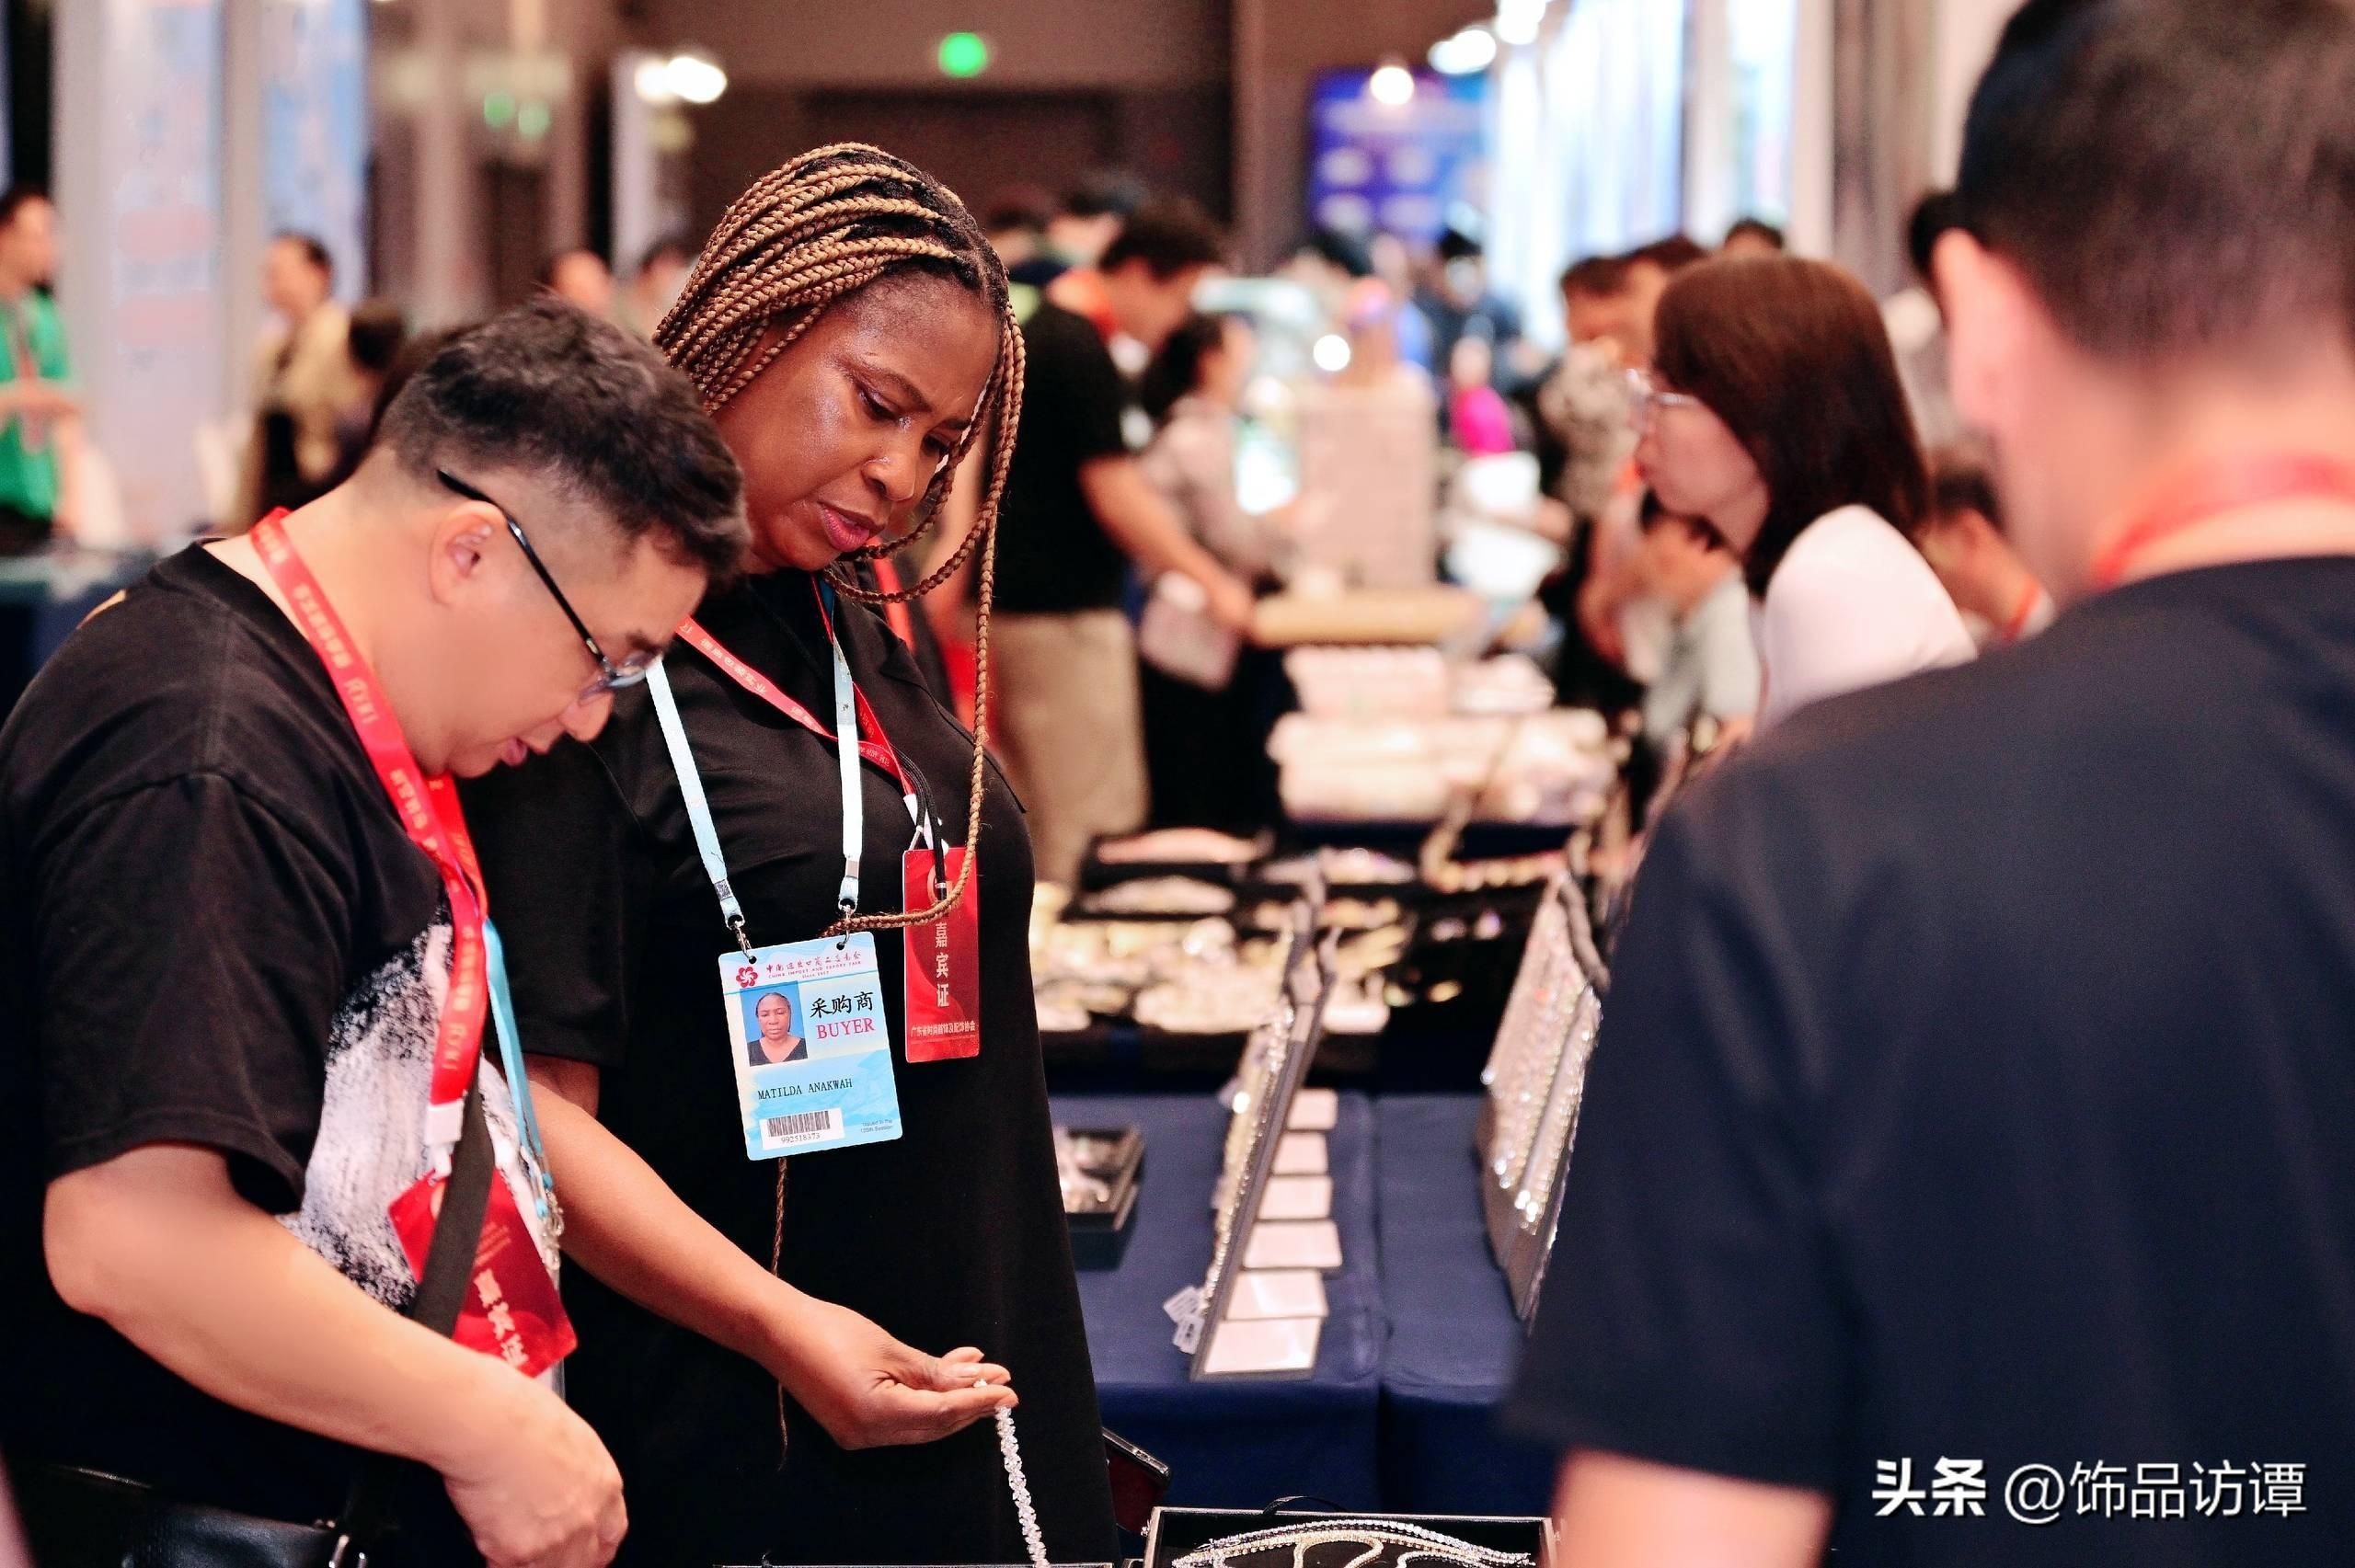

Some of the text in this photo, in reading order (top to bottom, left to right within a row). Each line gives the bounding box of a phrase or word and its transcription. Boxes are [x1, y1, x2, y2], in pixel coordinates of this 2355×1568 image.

[935, 922, 949, 1008] 嘉宾证
[810, 991, 874, 1019] 采购商
[816, 1017, 876, 1040] BUYER
[757, 1078, 853, 1100] MATILDA ANAKWAH
